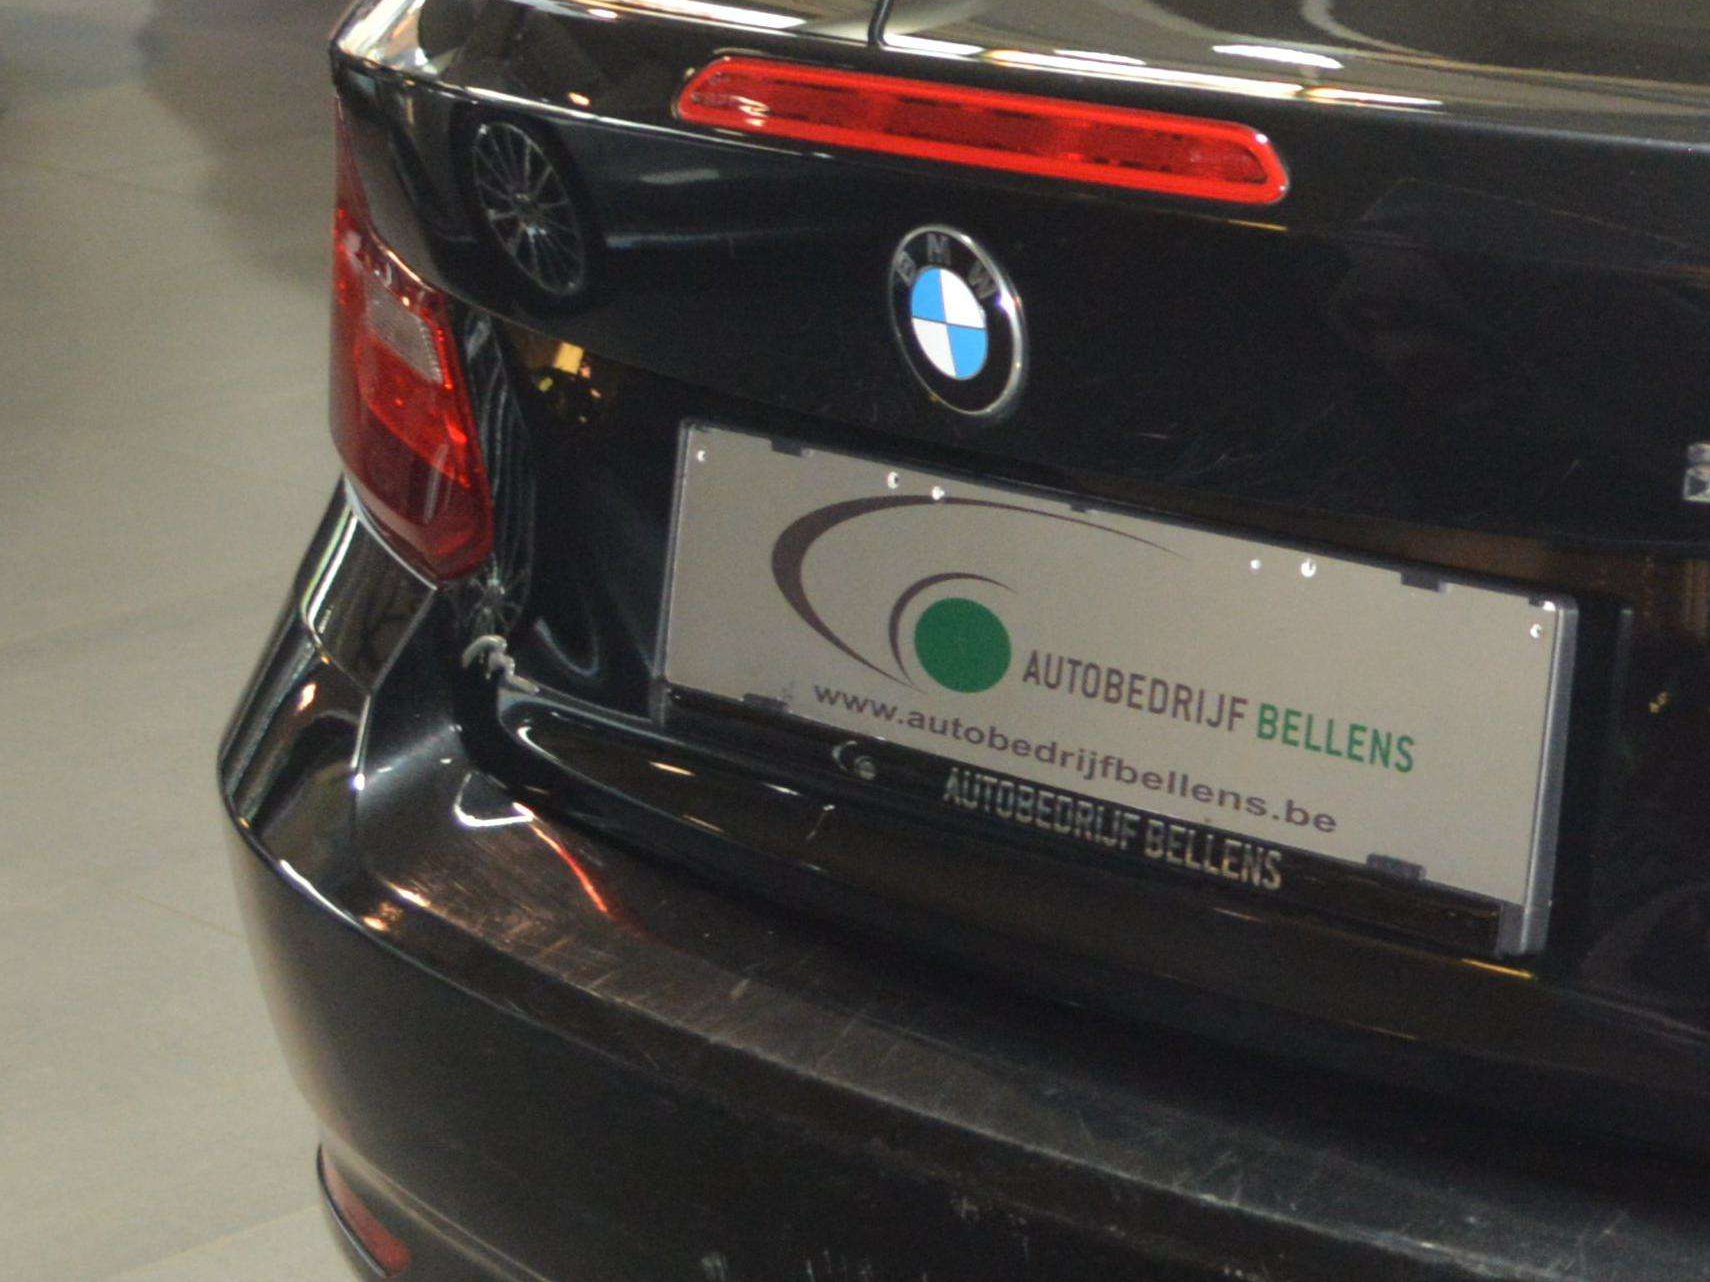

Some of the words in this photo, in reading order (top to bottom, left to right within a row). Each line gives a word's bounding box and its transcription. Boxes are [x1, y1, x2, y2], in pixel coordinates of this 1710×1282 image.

[813, 683, 1338, 835] www.autobedrijfbellens.be
[1022, 649, 1248, 733] AUTOBEDRIJF
[1256, 702, 1416, 774] BELLENS
[942, 766, 1142, 851] AUTOBEDRIJF
[1143, 819, 1284, 891] BELLENS
